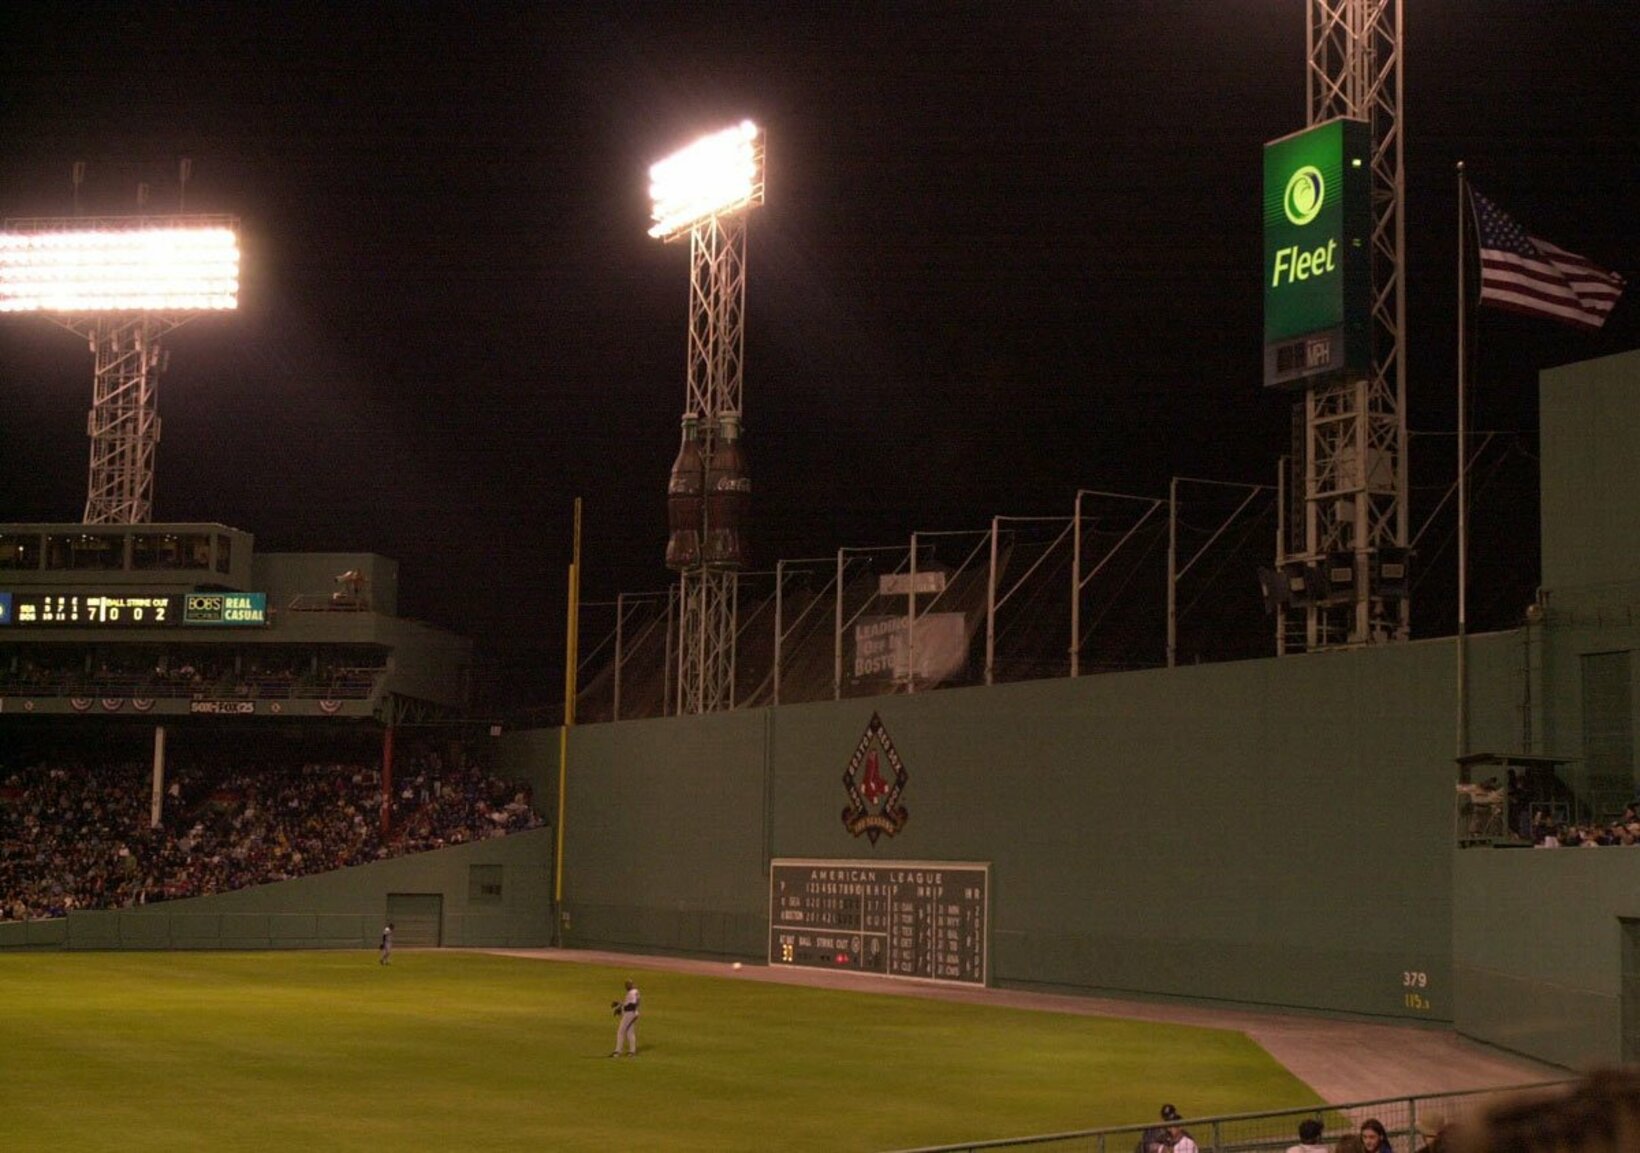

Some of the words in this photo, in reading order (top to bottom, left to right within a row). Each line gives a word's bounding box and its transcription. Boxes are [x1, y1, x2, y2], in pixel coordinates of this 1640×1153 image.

[1272, 238, 1337, 288] Fleet
[188, 597, 221, 610] BOB'S
[225, 597, 252, 609] REAL
[87, 607, 97, 620] 7
[109, 608, 119, 620] 0
[134, 608, 143, 620] 0
[155, 608, 165, 620] 2
[225, 609, 265, 621] CASUAL
[849, 728, 872, 775] BOSTON
[878, 727, 890, 750] RED
[888, 749, 901, 772] SOX
[811, 870, 876, 882] AMERICAN
[890, 872, 943, 884] LEAGUE
[836, 939, 849, 949] OUT
[1403, 971, 1427, 987] 379
